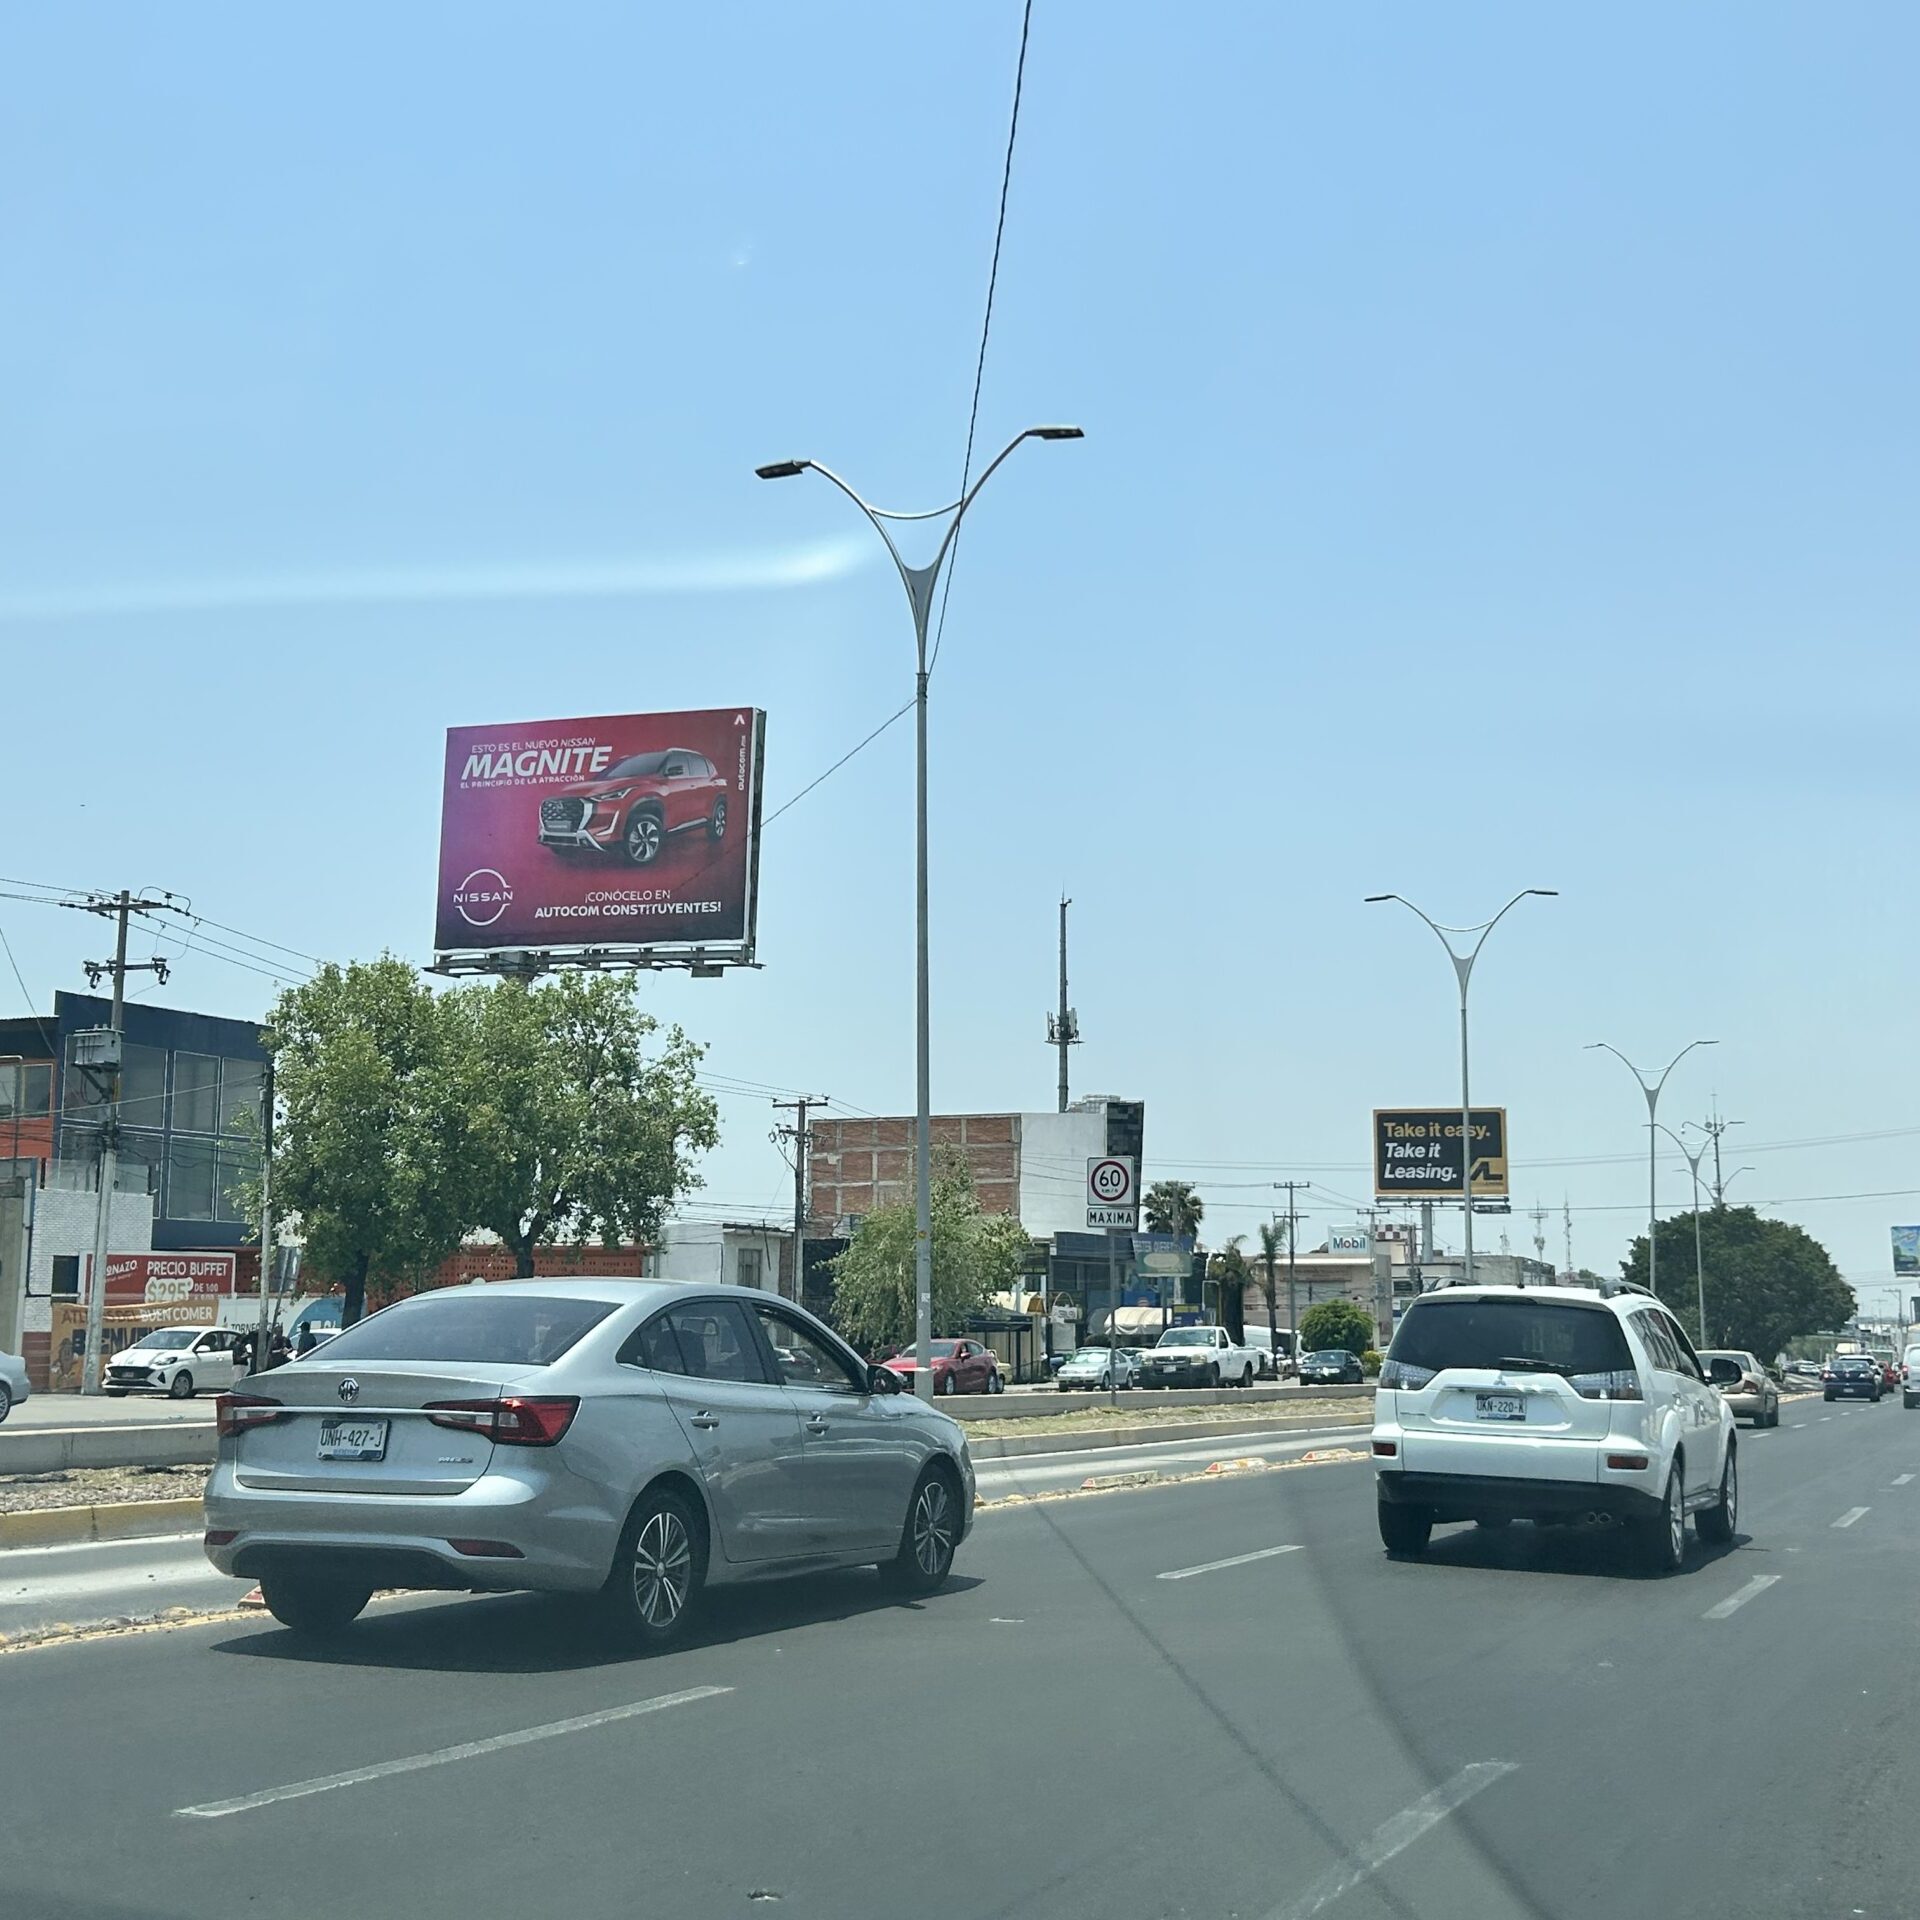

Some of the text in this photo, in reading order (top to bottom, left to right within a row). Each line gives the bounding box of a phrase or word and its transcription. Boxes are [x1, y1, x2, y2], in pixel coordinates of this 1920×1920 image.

[472, 737, 596, 753] ESTO ES EL NUEVO NISSAN
[461, 746, 613, 780] MAGNITE
[460, 775, 586, 789] EL PRINCIPIO DE LA ATRACCIÓN
[453, 891, 513, 903] NISSAN
[585, 889, 671, 903] ¡CONÓCELO EN
[535, 901, 722, 919] AUTOCOM CONSTITUYENTES!
[1383, 1122, 1426, 1137] Take
[1429, 1122, 1441, 1137] it
[1384, 1142, 1441, 1158] Take it
[1099, 1169, 1121, 1187] 60
[1384, 1163, 1457, 1182] Leasing.
[1089, 1211, 1133, 1224] MAXIMA
[1332, 1236, 1366, 1249] Mobil
[147, 1261, 228, 1277] PRECIO BUFFET
[194, 1283, 204, 1292] DE
[140, 1307, 172, 1322] BUEN
[173, 1306, 213, 1321] COMER
[320, 1429, 383, 1447] UNH-427-J
